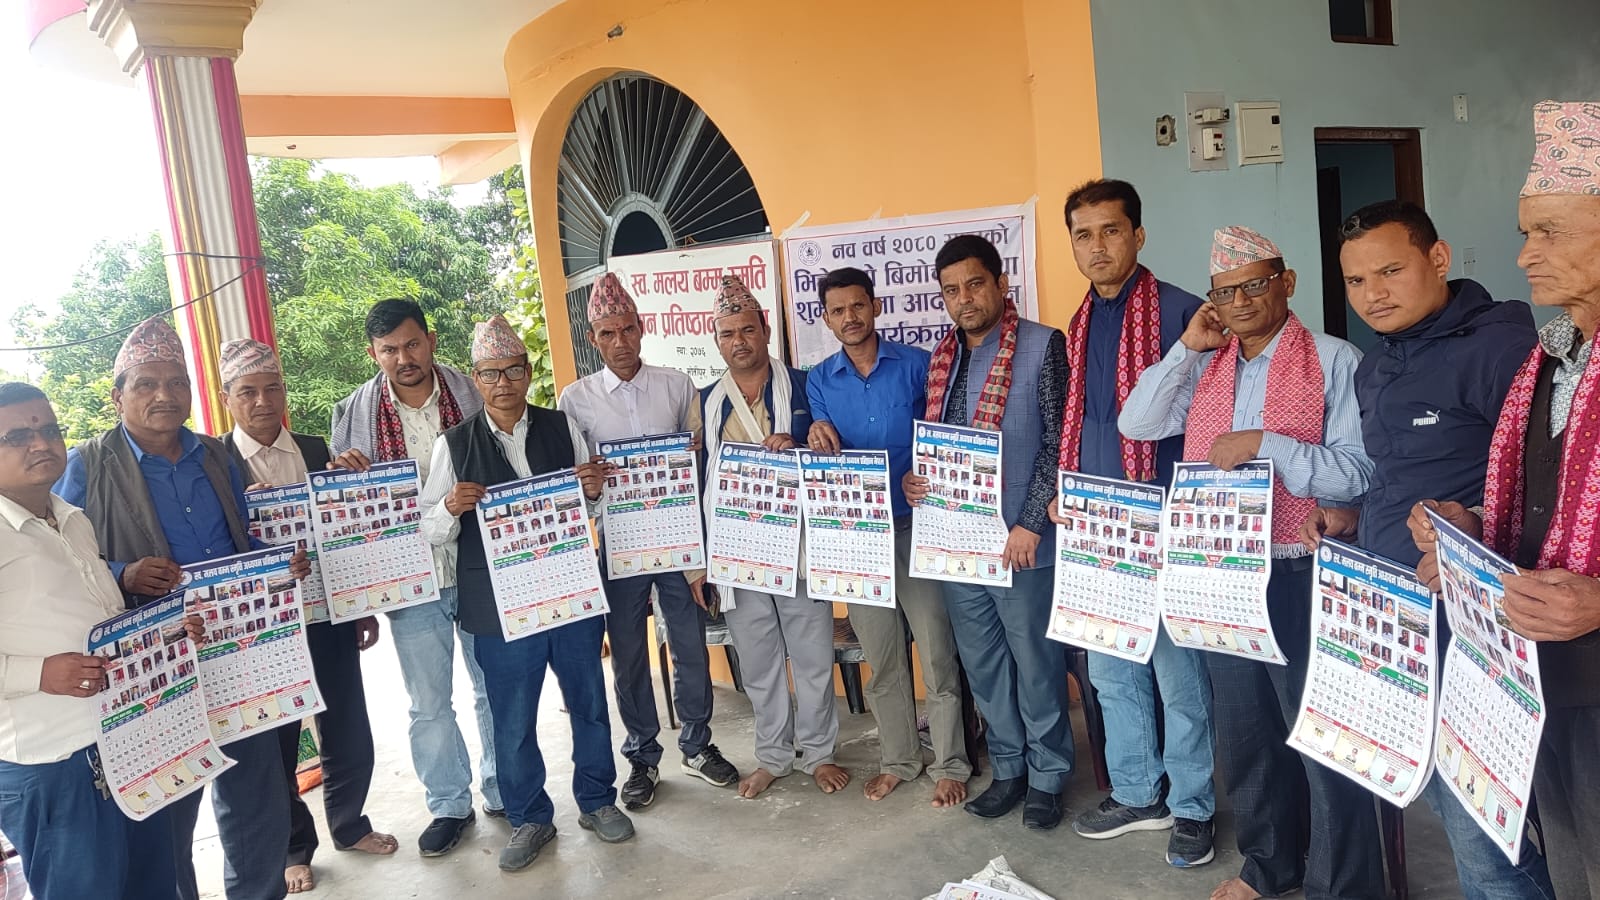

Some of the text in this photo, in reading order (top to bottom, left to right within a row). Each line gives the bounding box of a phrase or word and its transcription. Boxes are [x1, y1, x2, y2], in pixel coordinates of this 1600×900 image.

[832, 235, 936, 259] नव वर्ष २०८०
[630, 273, 651, 297] स्व.
[653, 270, 690, 295] मलय
